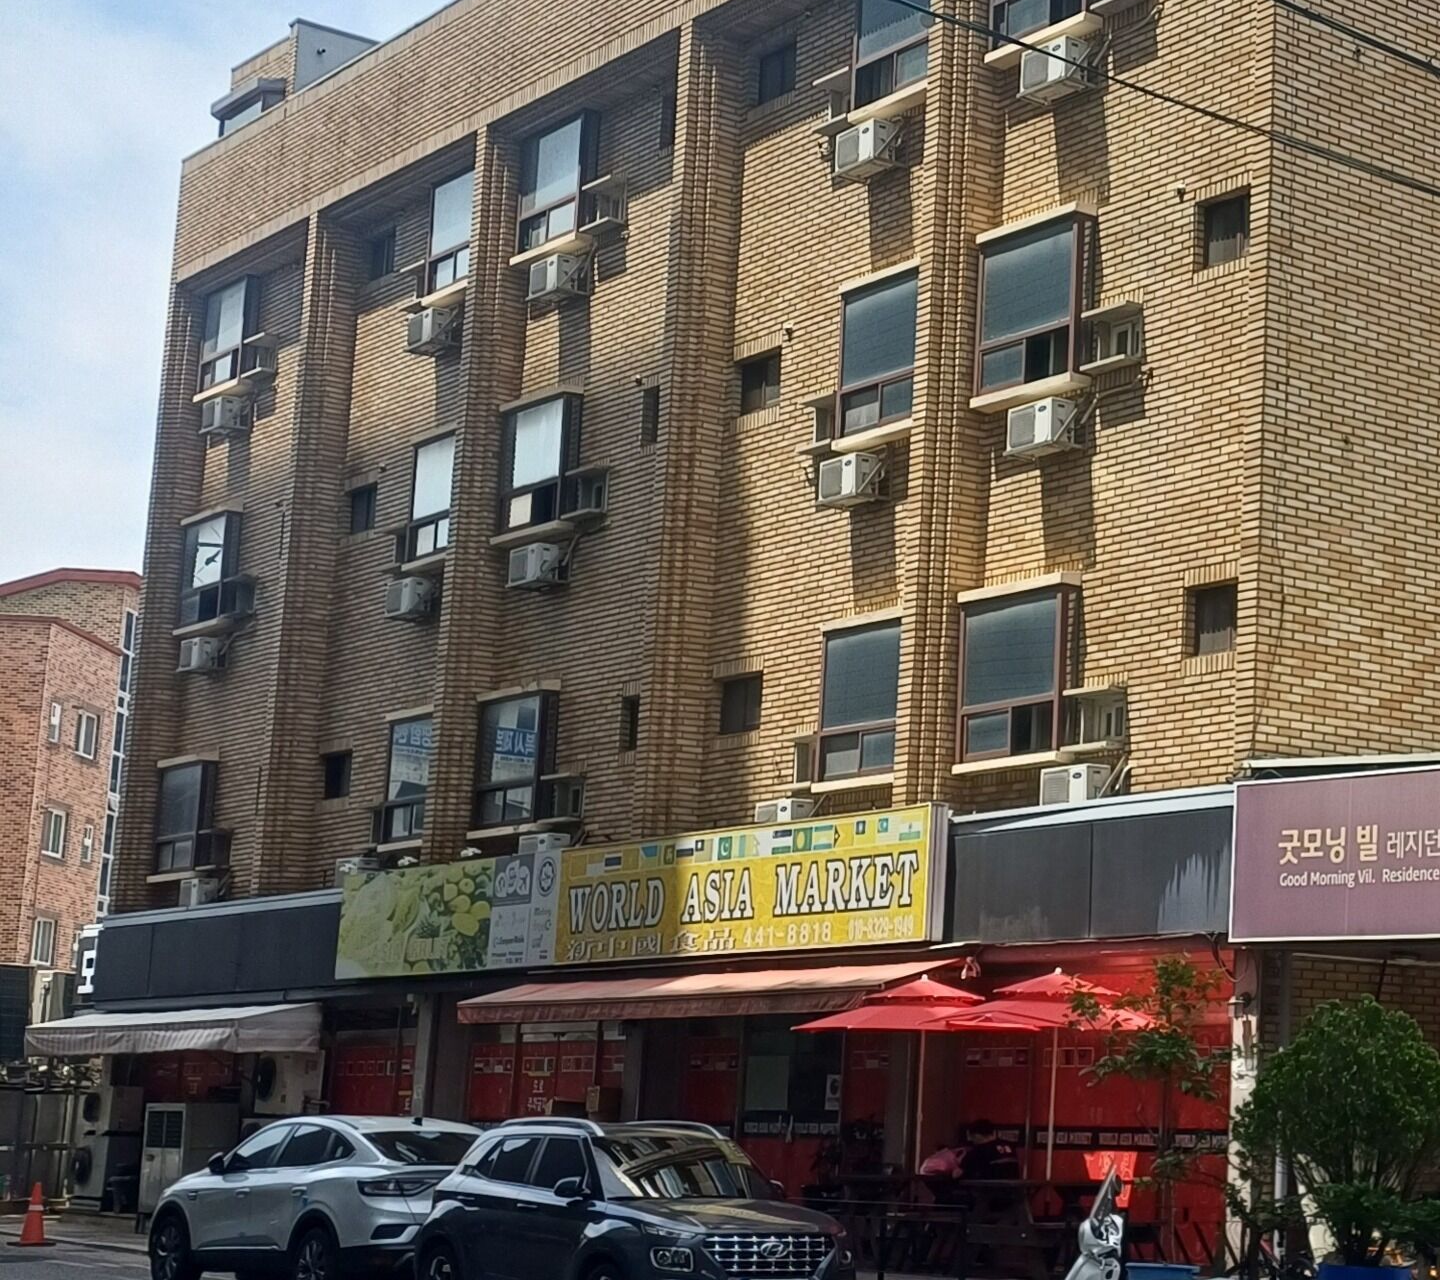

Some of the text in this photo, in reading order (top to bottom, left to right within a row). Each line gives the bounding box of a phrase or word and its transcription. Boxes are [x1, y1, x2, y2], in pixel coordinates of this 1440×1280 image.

[1278, 826, 1346, 865] 굿모닝
[1356, 824, 1378, 862] 빌
[568, 876, 666, 935] WORLD
[680, 867, 755, 925] ASIA
[773, 850, 919, 917] MARKET
[1279, 872, 1308, 887] Good
[1310, 870, 1356, 888] Morning
[1357, 868, 1376, 884] Vil.
[1382, 867, 1440, 883] Residence
[743, 921, 832, 947] 441-8818
